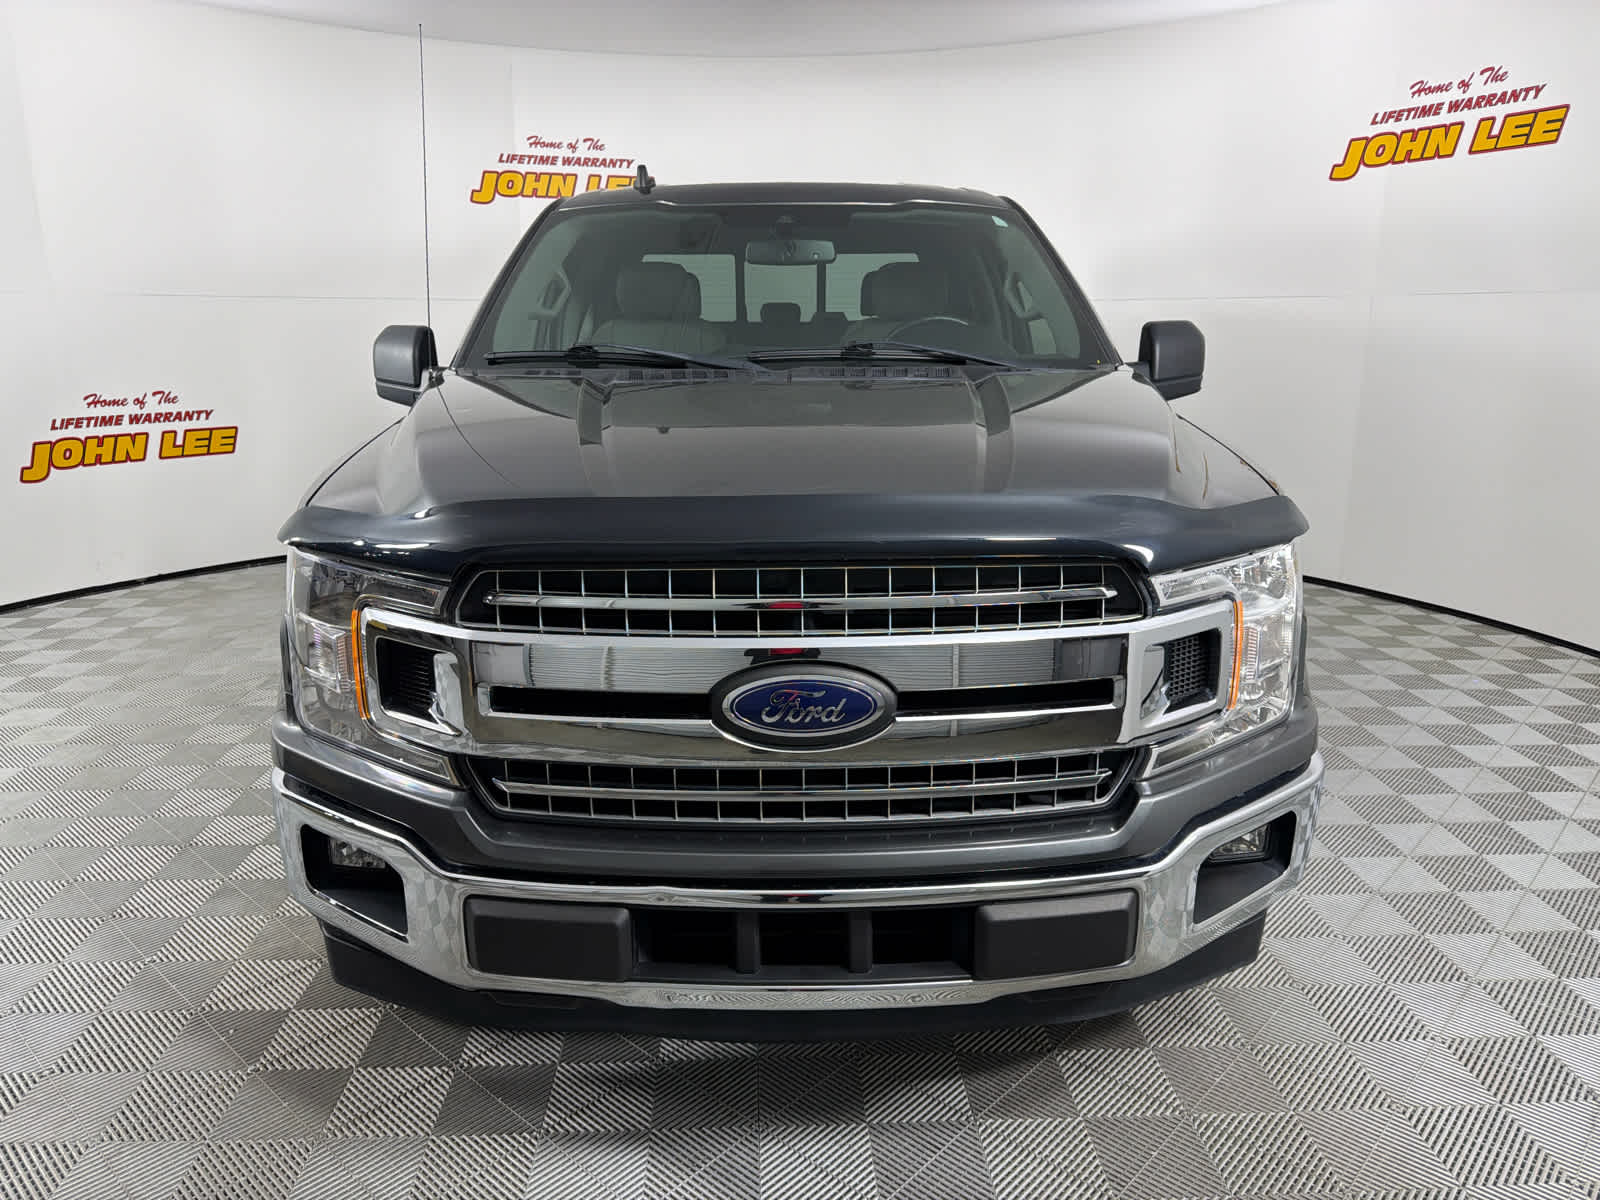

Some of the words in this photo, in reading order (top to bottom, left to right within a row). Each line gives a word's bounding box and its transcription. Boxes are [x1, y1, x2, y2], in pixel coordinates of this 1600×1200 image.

[1409, 80, 1453, 98] Home
[1457, 72, 1475, 94] of
[1479, 65, 1509, 86] The
[1370, 102, 1444, 126] LIFETIME
[1446, 83, 1547, 114] WARRANTY
[526, 135, 563, 150] Home
[566, 139, 580, 154] of
[582, 137, 606, 151] The
[1329, 121, 1465, 181] JOHN
[1468, 103, 1570, 155] LEE
[498, 153, 559, 166] LIFETIME
[561, 156, 635, 169] WARRANTY
[470, 170, 577, 205] JOHN
[585, 174, 656, 193] LE
[83, 393, 129, 409] Home
[132, 392, 147, 410] of
[151, 390, 180, 405] The
[50, 414, 124, 431] LIFETIME
[127, 409, 214, 425] WARRANTY
[20, 432, 149, 484] JOHN
[158, 426, 238, 460] LEE
[760, 688, 847, 724] Ford
